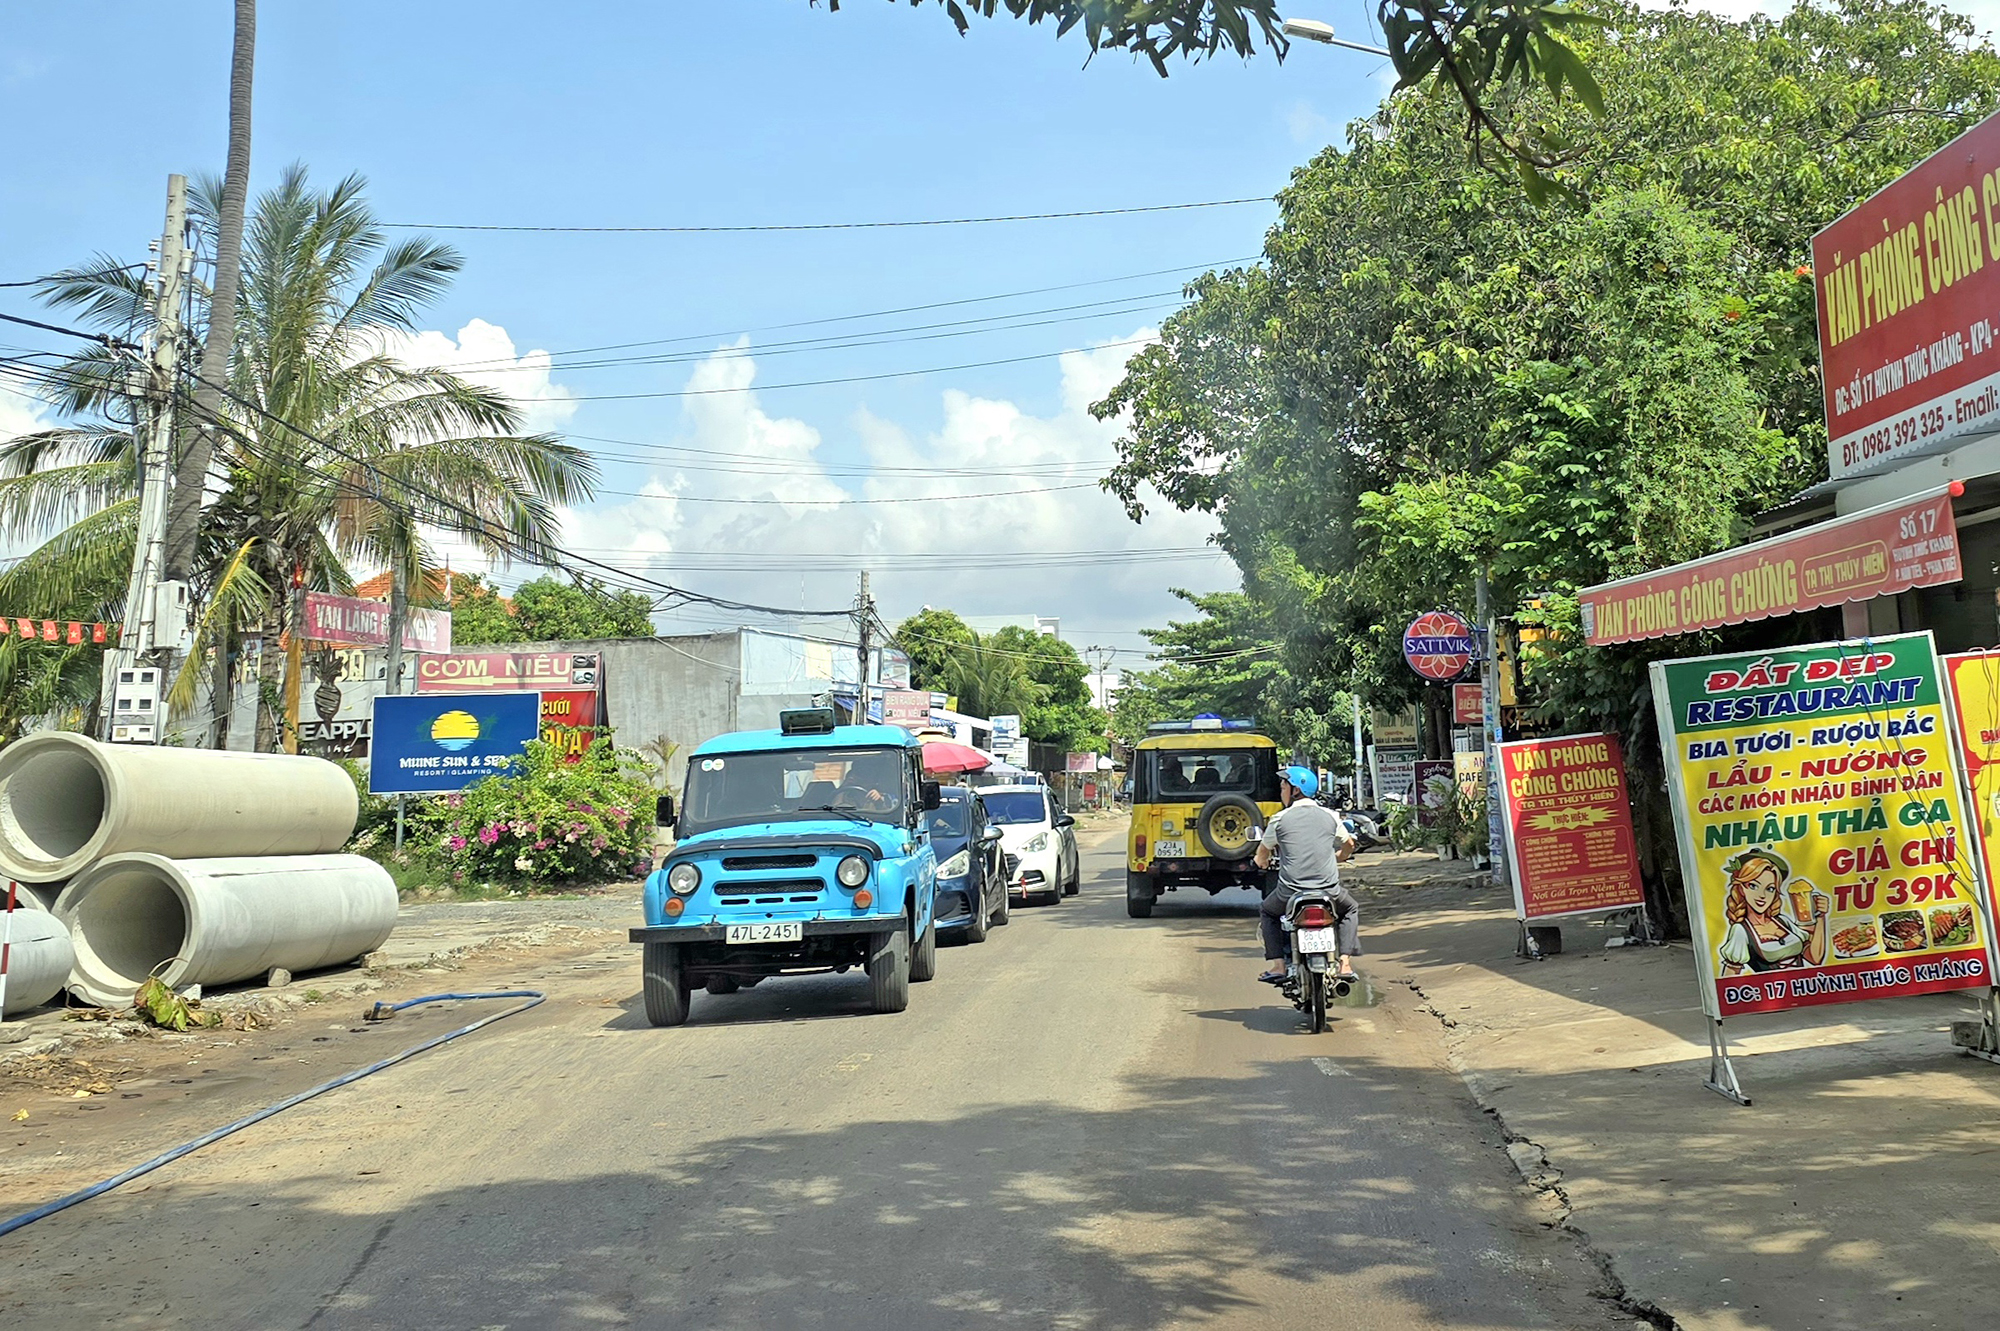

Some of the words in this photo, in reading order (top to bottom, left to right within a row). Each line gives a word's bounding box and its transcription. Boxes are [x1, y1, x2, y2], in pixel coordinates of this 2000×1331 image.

[1823, 250, 1861, 347] VĂN
[1860, 217, 1925, 330] PHÒNG
[1924, 185, 1981, 295] CÔNG
[1862, 373, 1874, 404] 17
[1874, 358, 1905, 399] HUỲNH
[1904, 344, 1929, 385] THÚC
[1929, 331, 1964, 375] KHÁNG
[1970, 318, 1993, 357] KP4
[1843, 440, 1860, 467] ĐT:
[1862, 427, 1892, 460] 0982
[1894, 416, 1918, 448] 392
[1920, 406, 1945, 438] 325
[1955, 385, 2000, 424] Email:
[1919, 508, 1936, 534] 17
[1596, 595, 1624, 639] VĂN
[1626, 585, 1678, 634] PHÒNG
[1680, 574, 1727, 626] CÔNG
[1730, 556, 1799, 616] CHỨNG
[316, 604, 342, 634] VẠN
[345, 604, 378, 635] LĂNG
[421, 659, 488, 678] CƠM
[505, 653, 571, 677] NIÊU
[1406, 638, 1470, 654] SATTVIK
[1706, 658, 1797, 692] ĐẤT
[1805, 653, 1894, 681] ĐẸP
[1687, 677, 1922, 725] RESTAURANT
[1511, 747, 1548, 772] VĂN
[1550, 741, 1609, 768] PHÒNG
[1689, 740, 1727, 760] BIA
[1735, 730, 1792, 755] TƯƠI
[1811, 722, 1880, 747] RƯỢU
[1887, 712, 1935, 738] BẮC
[400, 756, 440, 769] MUINE
[442, 755, 468, 767] SUN
[470, 755, 481, 767] &
[414, 769, 445, 777] RESORT
[451, 768, 493, 776] GLAMPING
[1510, 773, 1558, 798] CÔNG
[1560, 766, 1619, 792] CHỨNG
[1707, 759, 1772, 790] LẨU
[1800, 748, 1927, 779] NƯỚNG
[1698, 790, 1734, 814] CÁC
[1740, 786, 1786, 810] MÓN
[1791, 781, 1845, 807] NHẬU
[1851, 775, 1897, 796] BÌNH
[1902, 770, 1943, 792] DÂN
[1705, 811, 1808, 851] NHẬU
[1817, 798, 1888, 834] THẢ
[1898, 798, 1952, 827] GA
[1829, 837, 1891, 876] GIÁ
[1900, 827, 1956, 867] CHỈ
[1833, 876, 1878, 912] TỪ
[1886, 872, 1959, 906] 39K
[1726, 985, 1761, 1005] ĐC:
[1765, 982, 1786, 999] 17
[1792, 971, 1856, 998] HUỲNH
[1860, 964, 1911, 991] THÚC
[1915, 957, 1983, 983] KHÁNG
